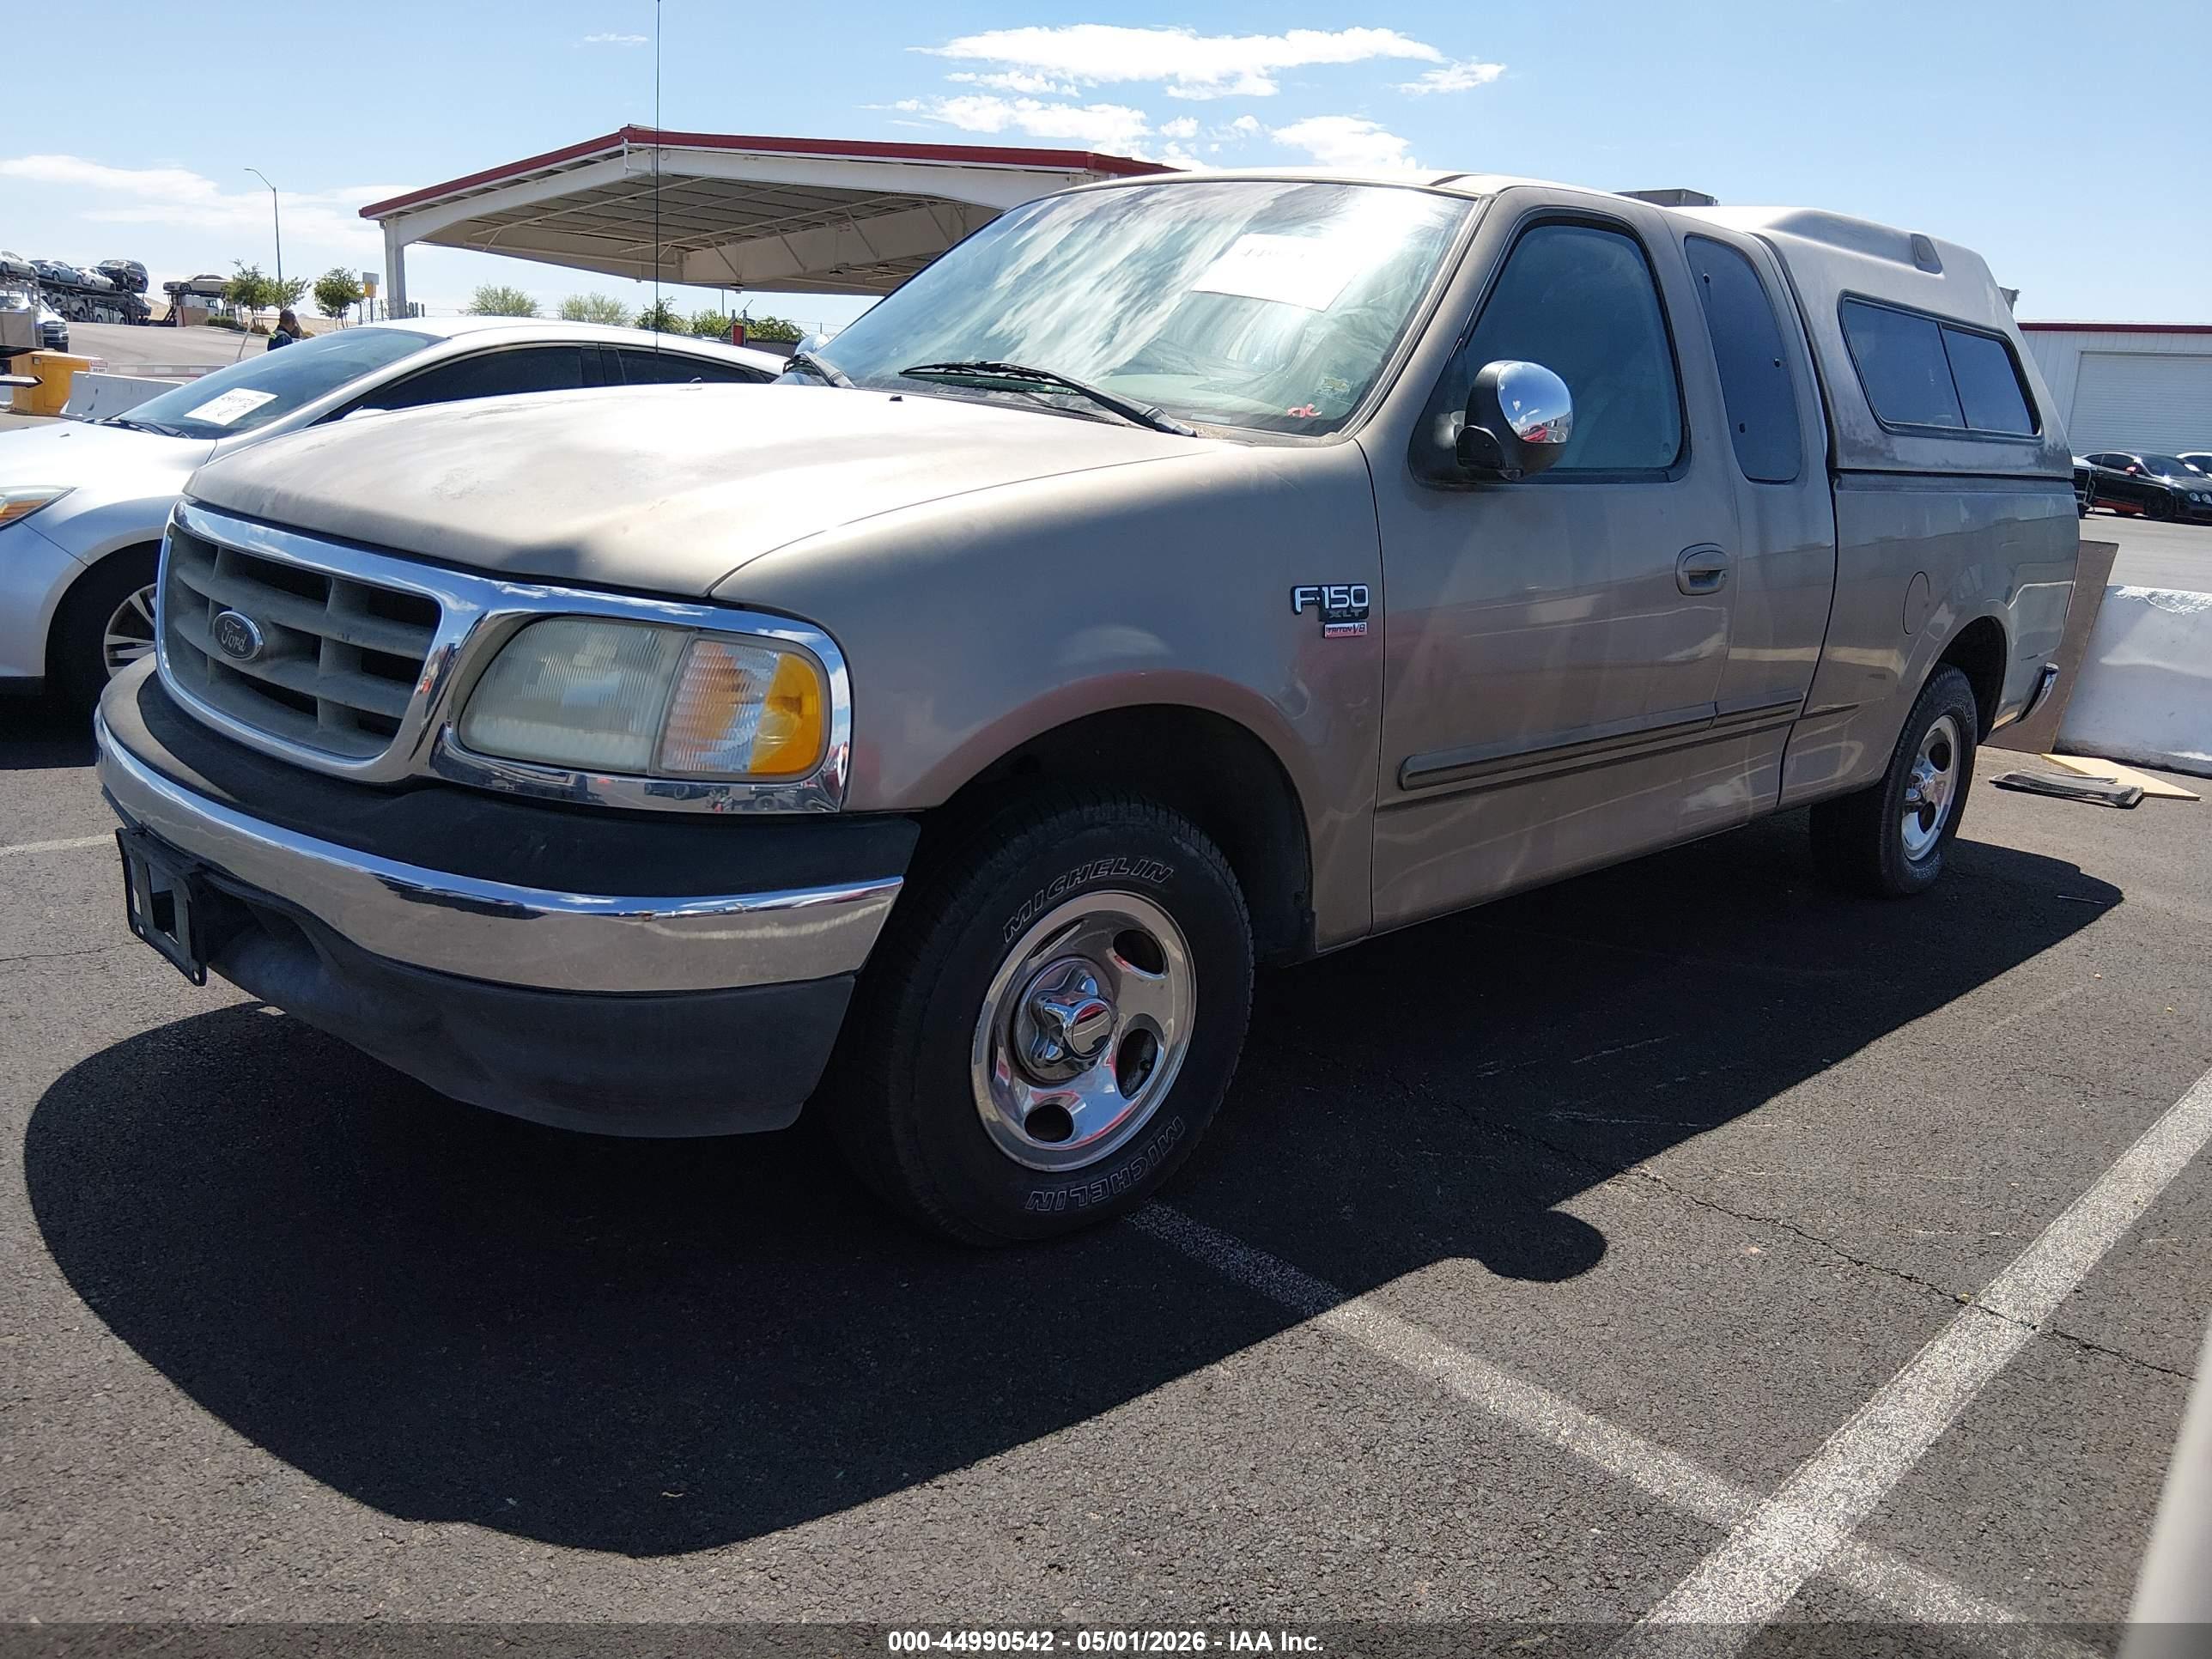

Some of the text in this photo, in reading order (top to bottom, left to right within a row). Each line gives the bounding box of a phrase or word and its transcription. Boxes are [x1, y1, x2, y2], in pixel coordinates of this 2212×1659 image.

[1328, 609, 1364, 618] XLT
[1352, 623, 1366, 635] V8
[221, 619, 248, 653] Ford
[1002, 856, 1175, 944] MICHELIN
[1024, 1115, 1184, 1212] MICHELIN
